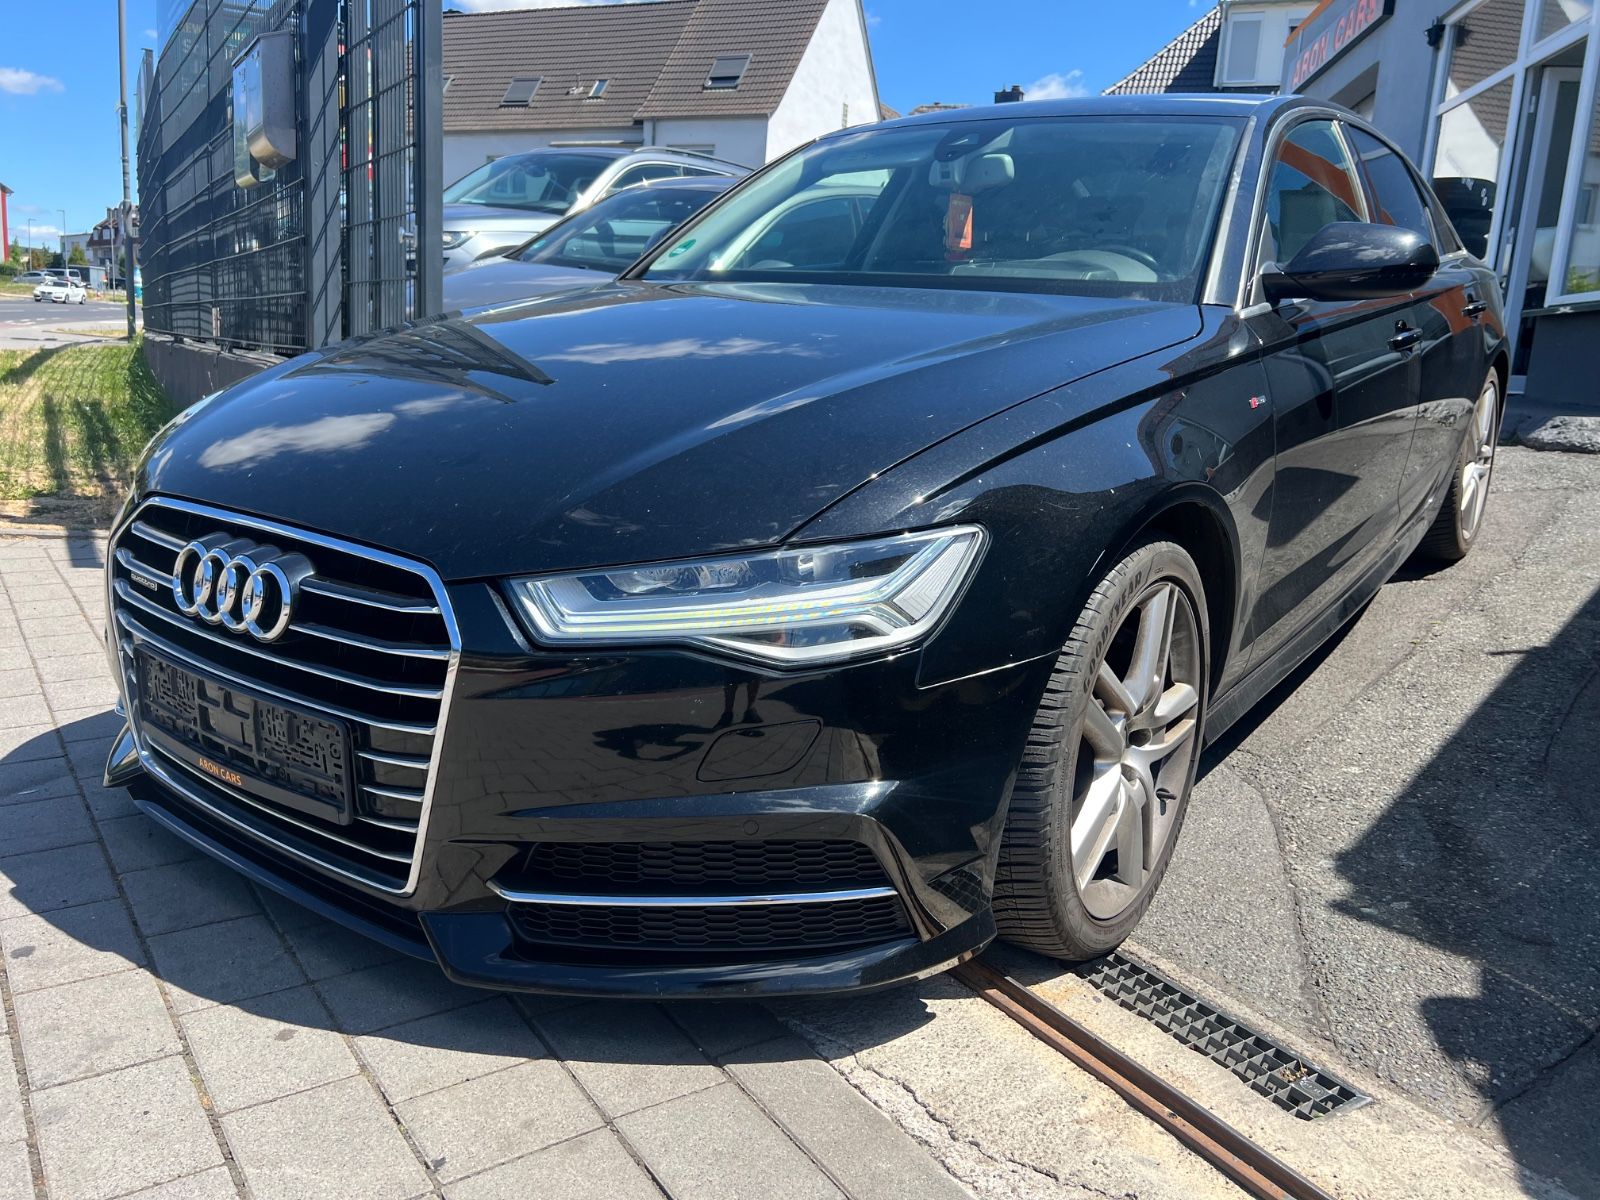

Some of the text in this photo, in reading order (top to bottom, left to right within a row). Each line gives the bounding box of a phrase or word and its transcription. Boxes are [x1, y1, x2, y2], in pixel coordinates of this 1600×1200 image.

[1292, 0, 1377, 88] ARON CARS
[199, 757, 242, 786] ARON CARS
